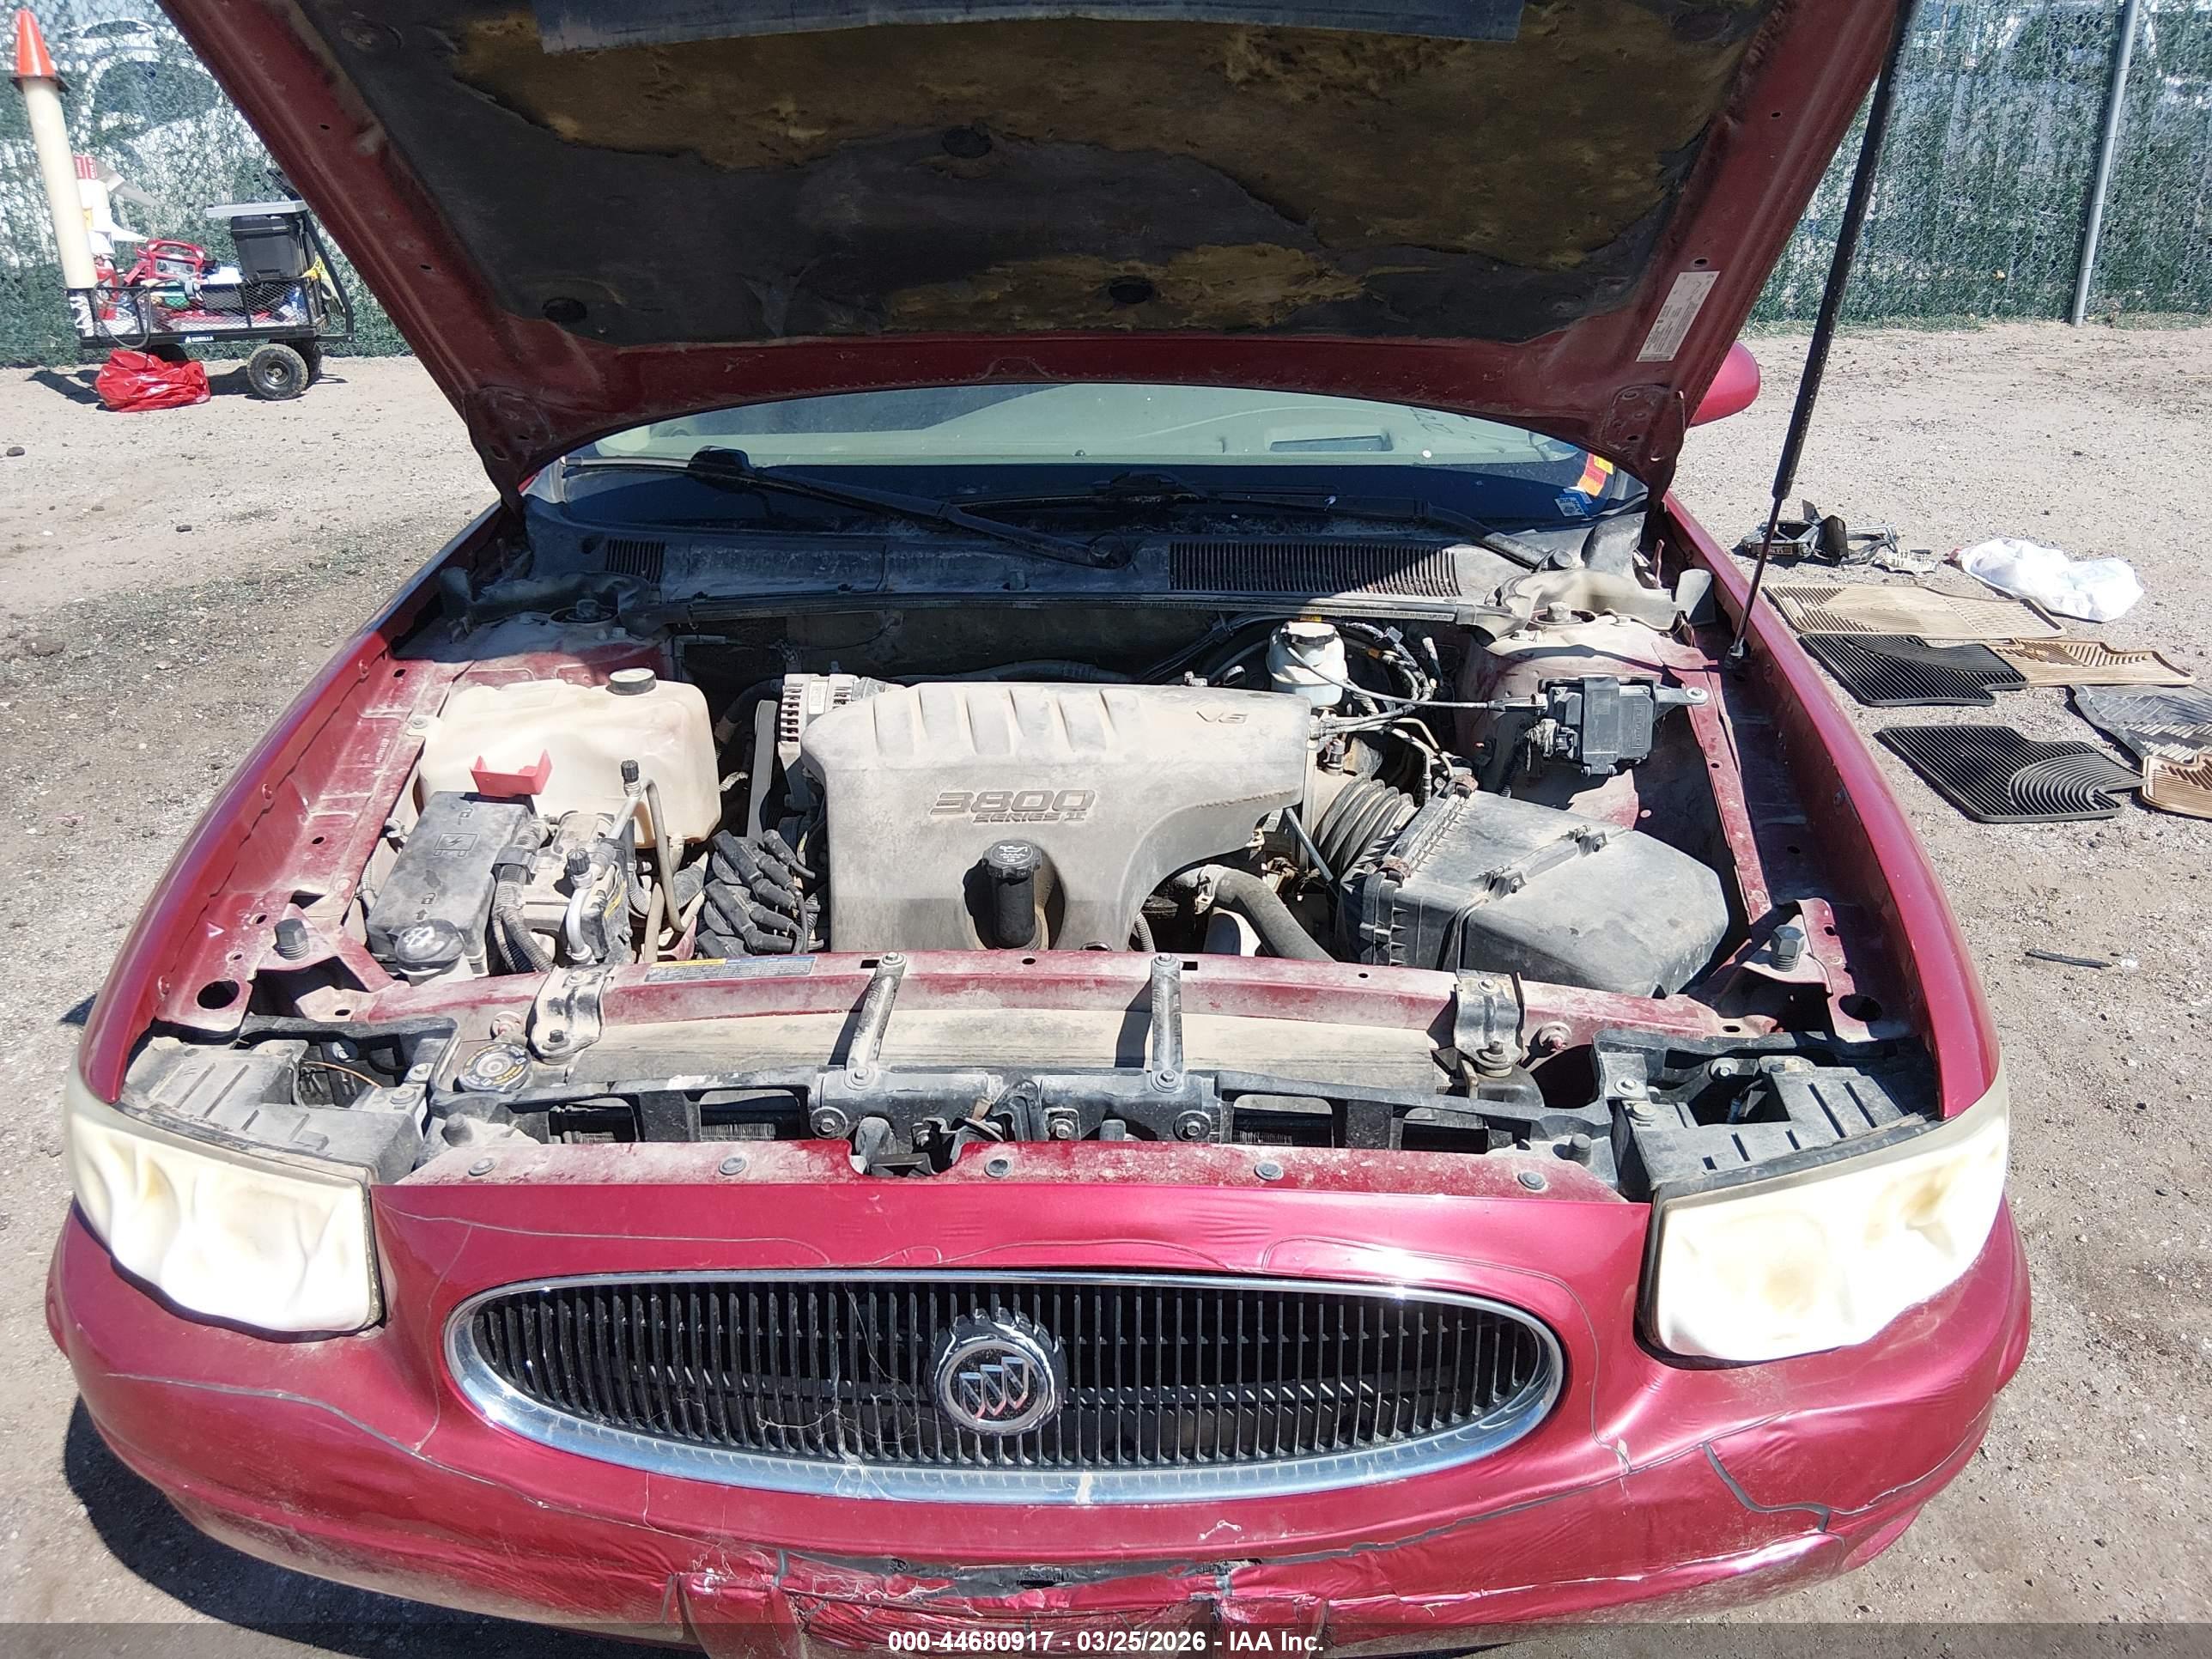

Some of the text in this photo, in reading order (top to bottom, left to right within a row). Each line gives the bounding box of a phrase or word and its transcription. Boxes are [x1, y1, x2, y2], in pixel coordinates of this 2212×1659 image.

[1195, 711, 1249, 724] V6
[930, 789, 1096, 815] 3800
[972, 812, 1060, 823] SERIES
